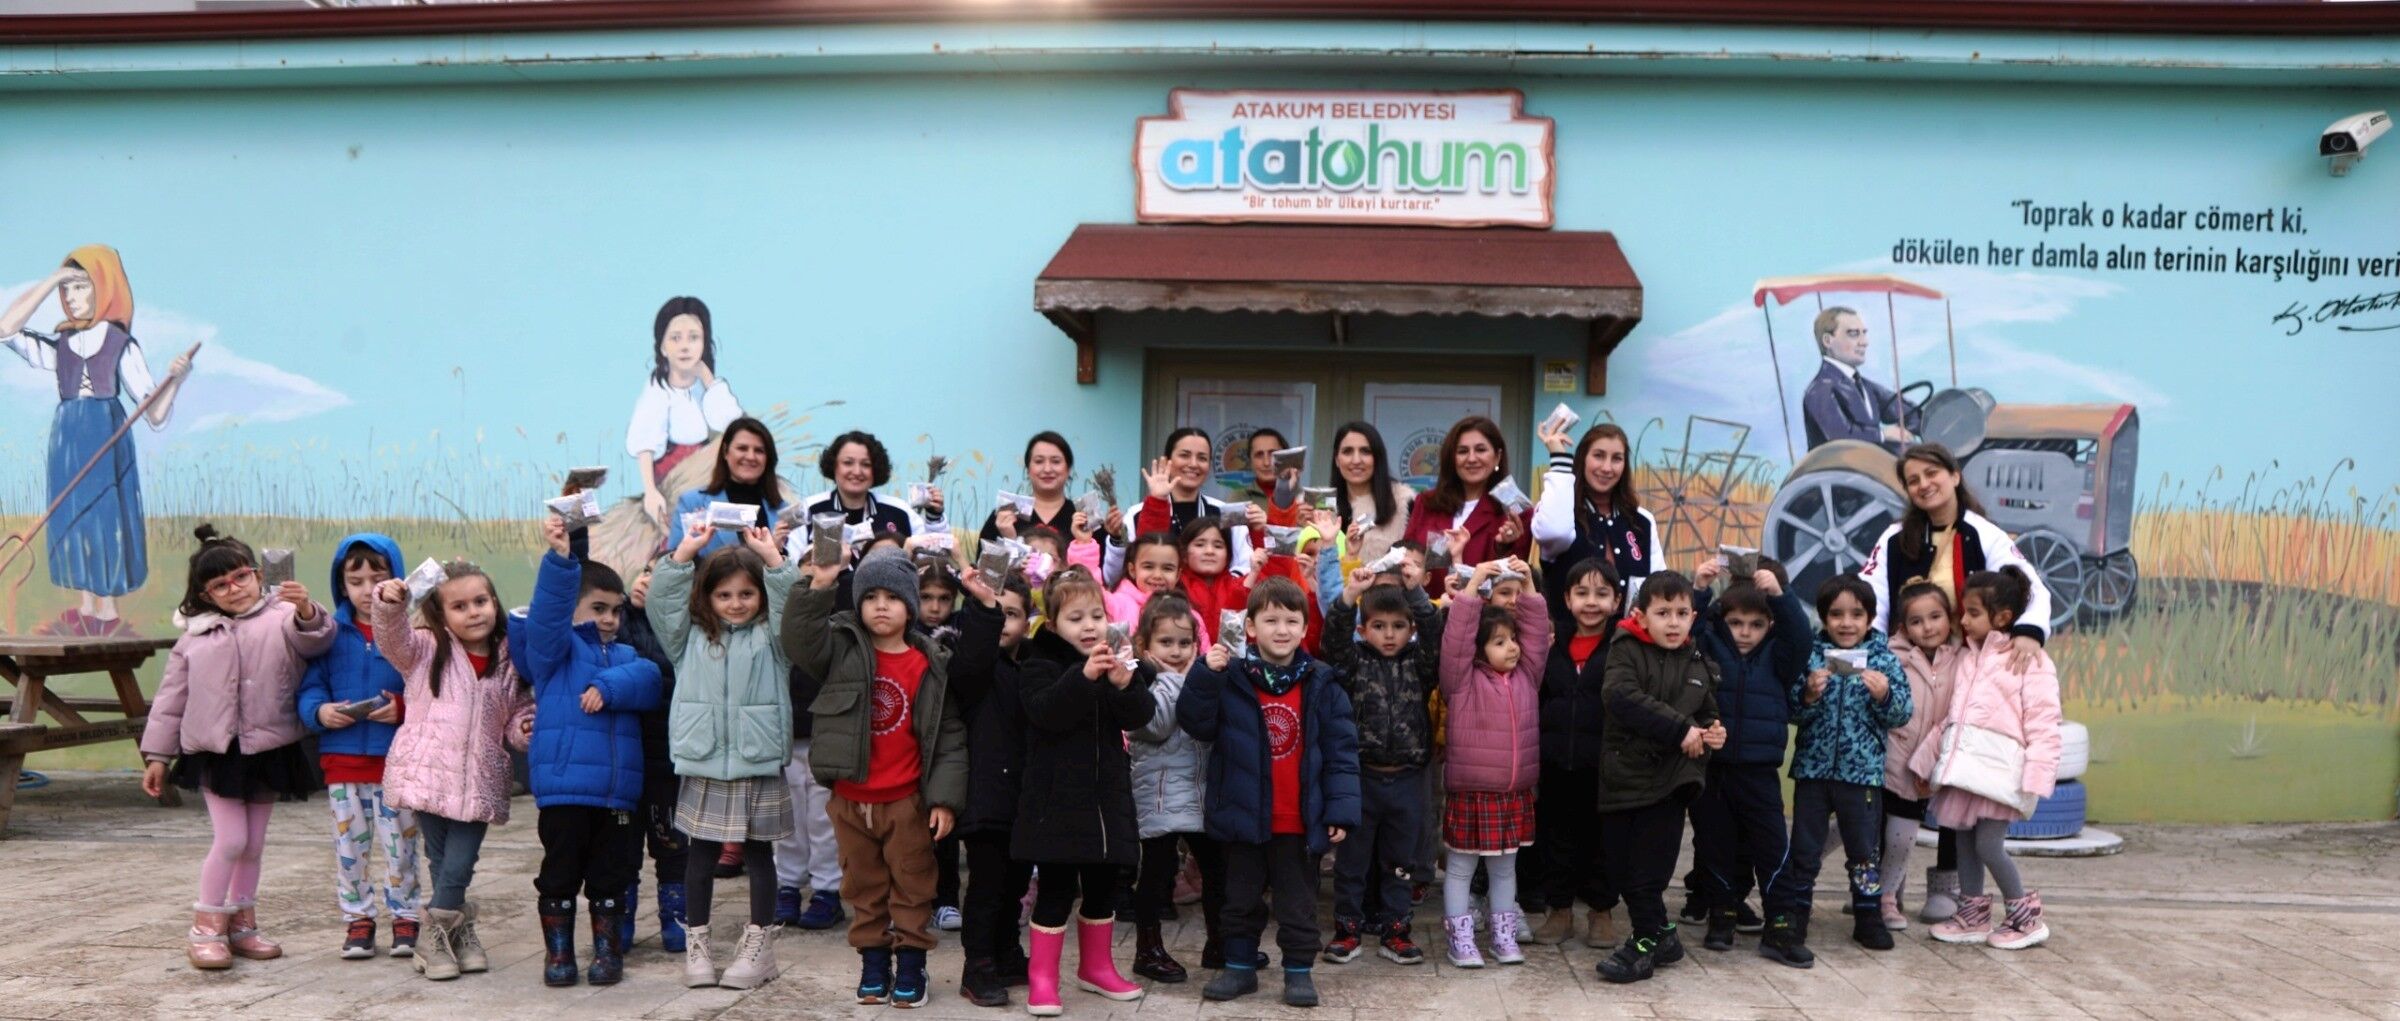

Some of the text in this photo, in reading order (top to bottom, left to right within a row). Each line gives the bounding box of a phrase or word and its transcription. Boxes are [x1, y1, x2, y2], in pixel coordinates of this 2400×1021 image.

[1231, 101, 1456, 120] ATAKUM BELEDİYESİ
[1160, 123, 1526, 187] atatohum
[1271, 195, 1311, 209] tohum
[2102, 209, 2114, 228] o
[2122, 203, 2187, 230] kadar
[2195, 206, 2275, 232] cömert
[2281, 207, 2307, 235] ki,
[1893, 239, 1979, 265] dökülen
[1988, 240, 2024, 266] her
[2032, 241, 2099, 269] damla
[2106, 244, 2146, 270] alın
[2154, 247, 2227, 272] terinin
[2235, 247, 2349, 283] karşılığını
[1625, 530, 1643, 562] S
